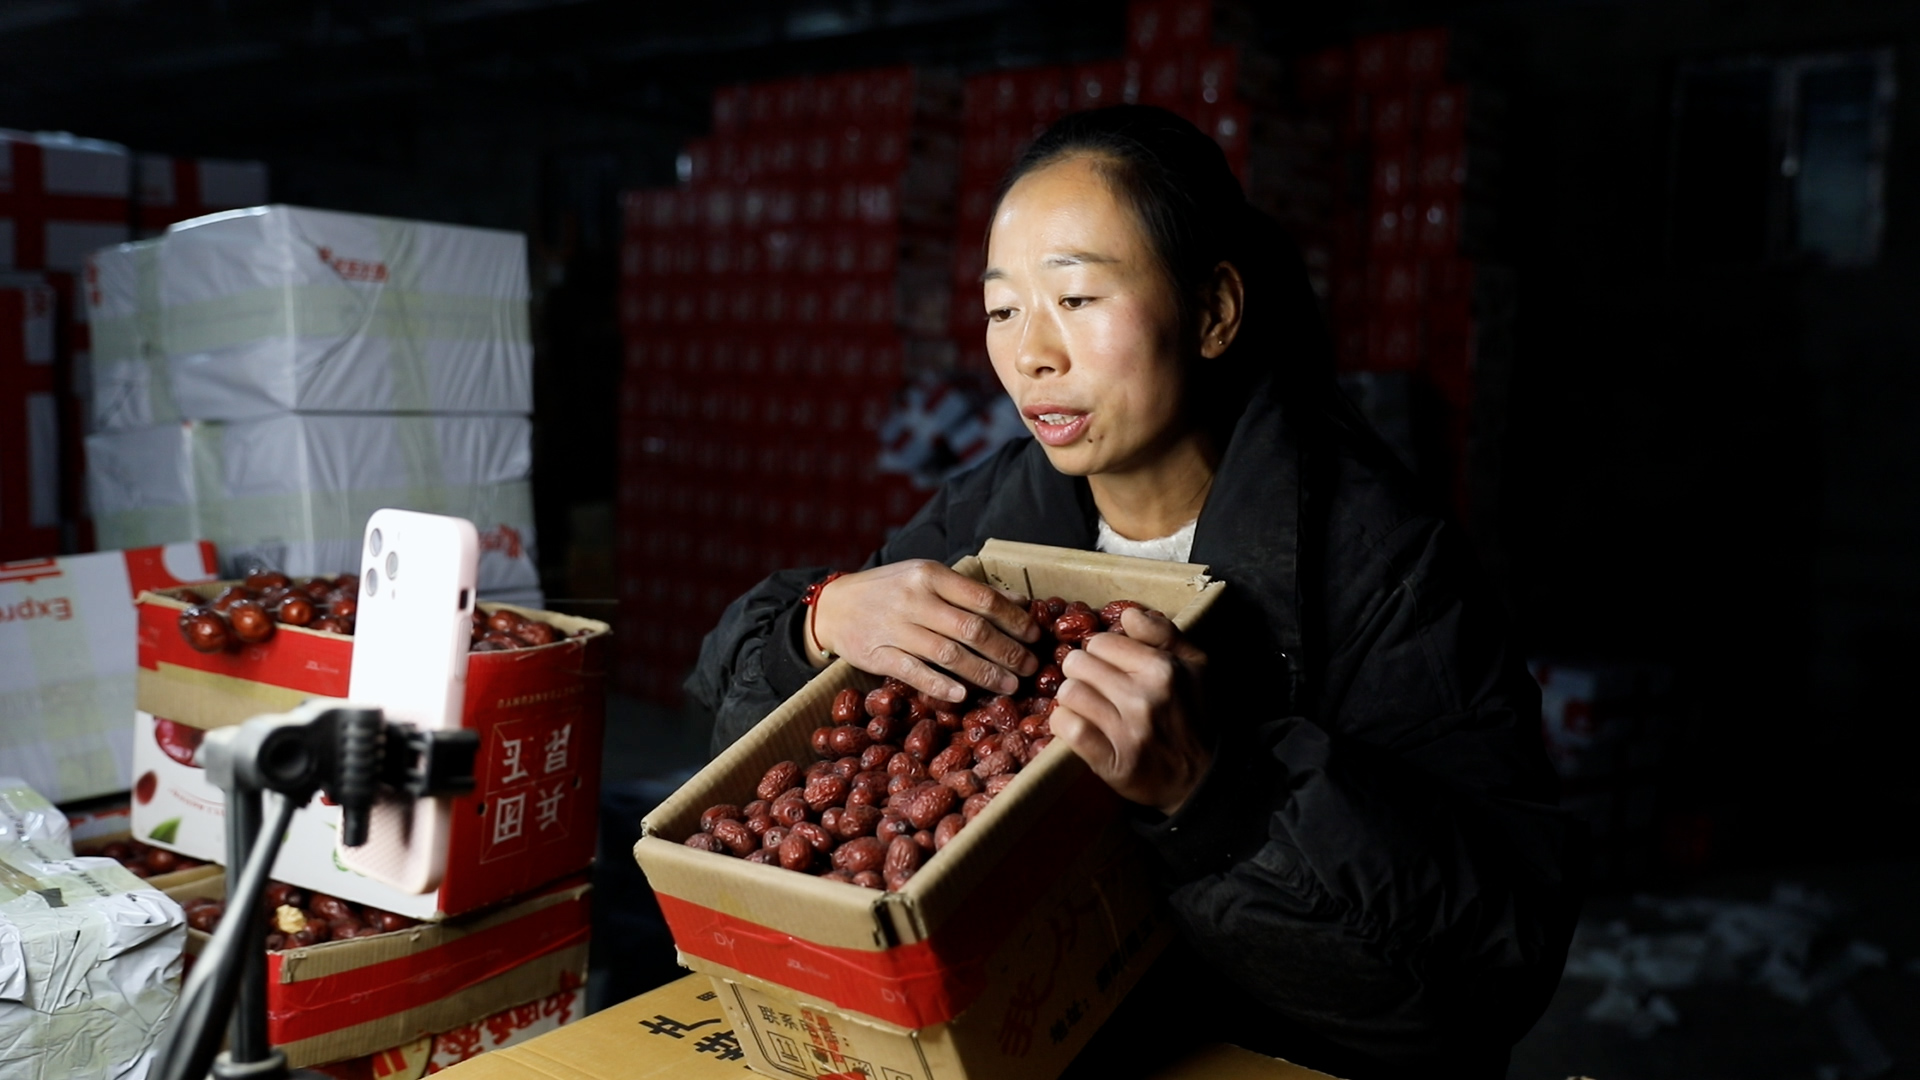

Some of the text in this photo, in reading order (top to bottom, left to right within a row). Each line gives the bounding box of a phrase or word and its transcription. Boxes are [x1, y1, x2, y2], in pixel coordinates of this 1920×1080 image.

[0, 596, 73, 622] Expr
[492, 780, 565, 845] 兵团
[714, 931, 735, 950] DY
[881, 987, 909, 1004] DY
[639, 1014, 752, 1070] 特产
